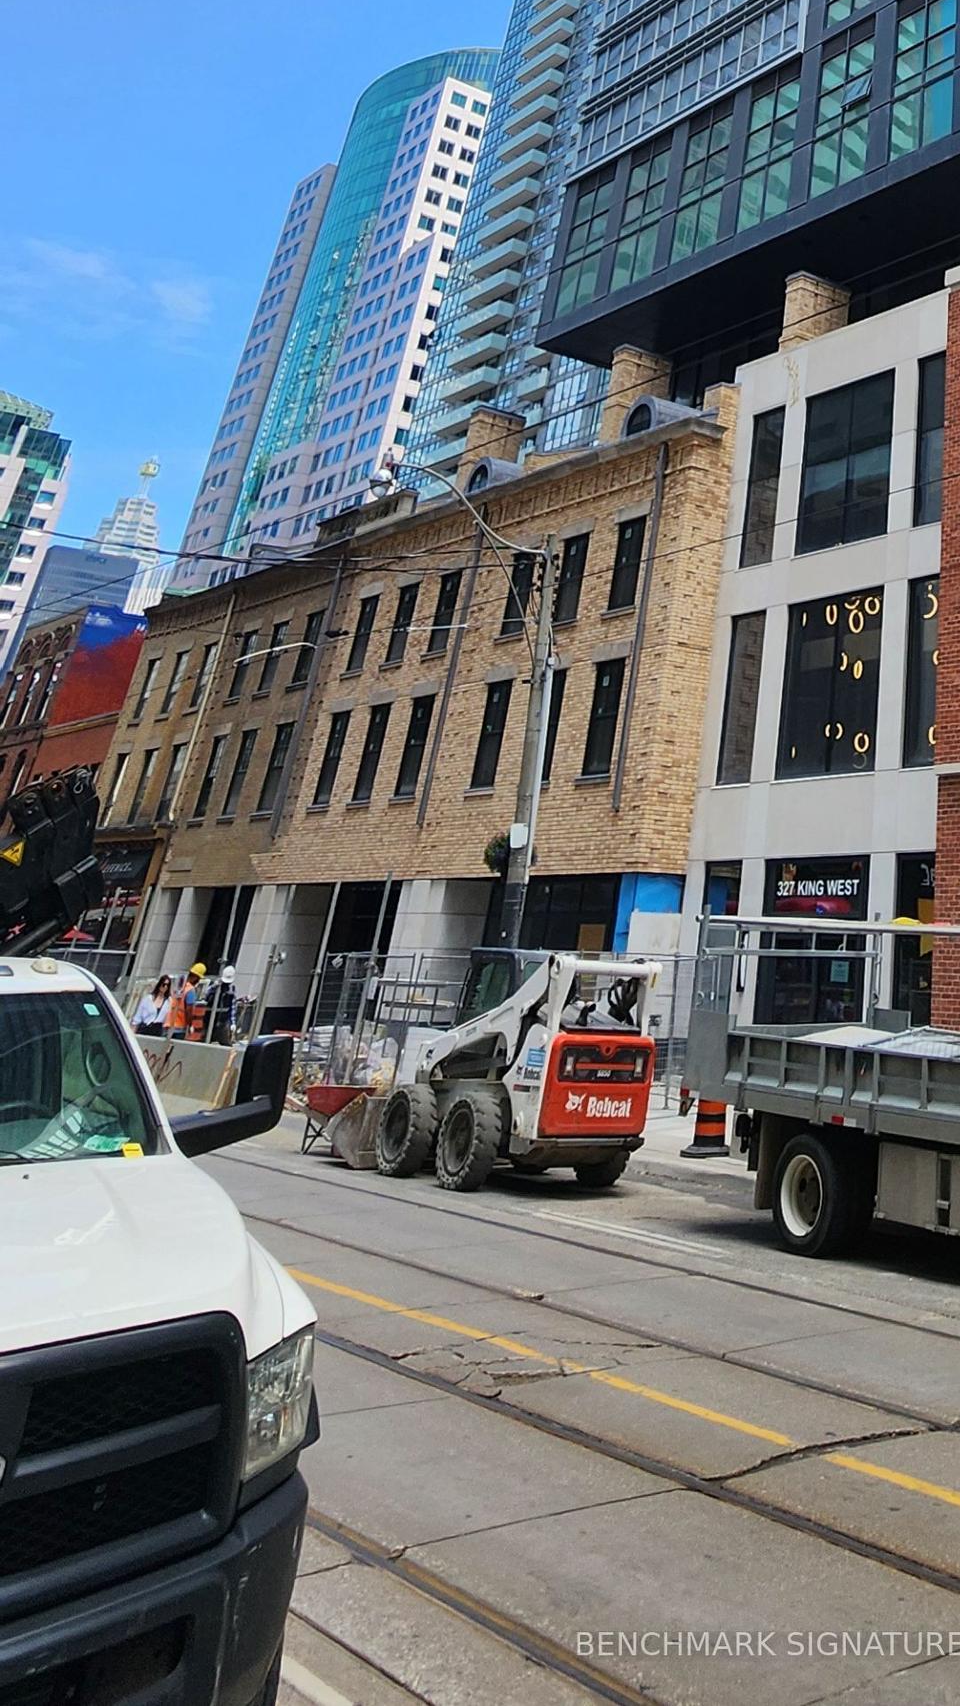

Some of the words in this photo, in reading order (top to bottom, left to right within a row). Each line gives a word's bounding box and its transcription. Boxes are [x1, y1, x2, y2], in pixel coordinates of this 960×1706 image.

[776, 880, 795, 896] 327
[797, 880, 825, 896] KING
[826, 879, 860, 896] WEST
[585, 1096, 633, 1118] Bobcat
